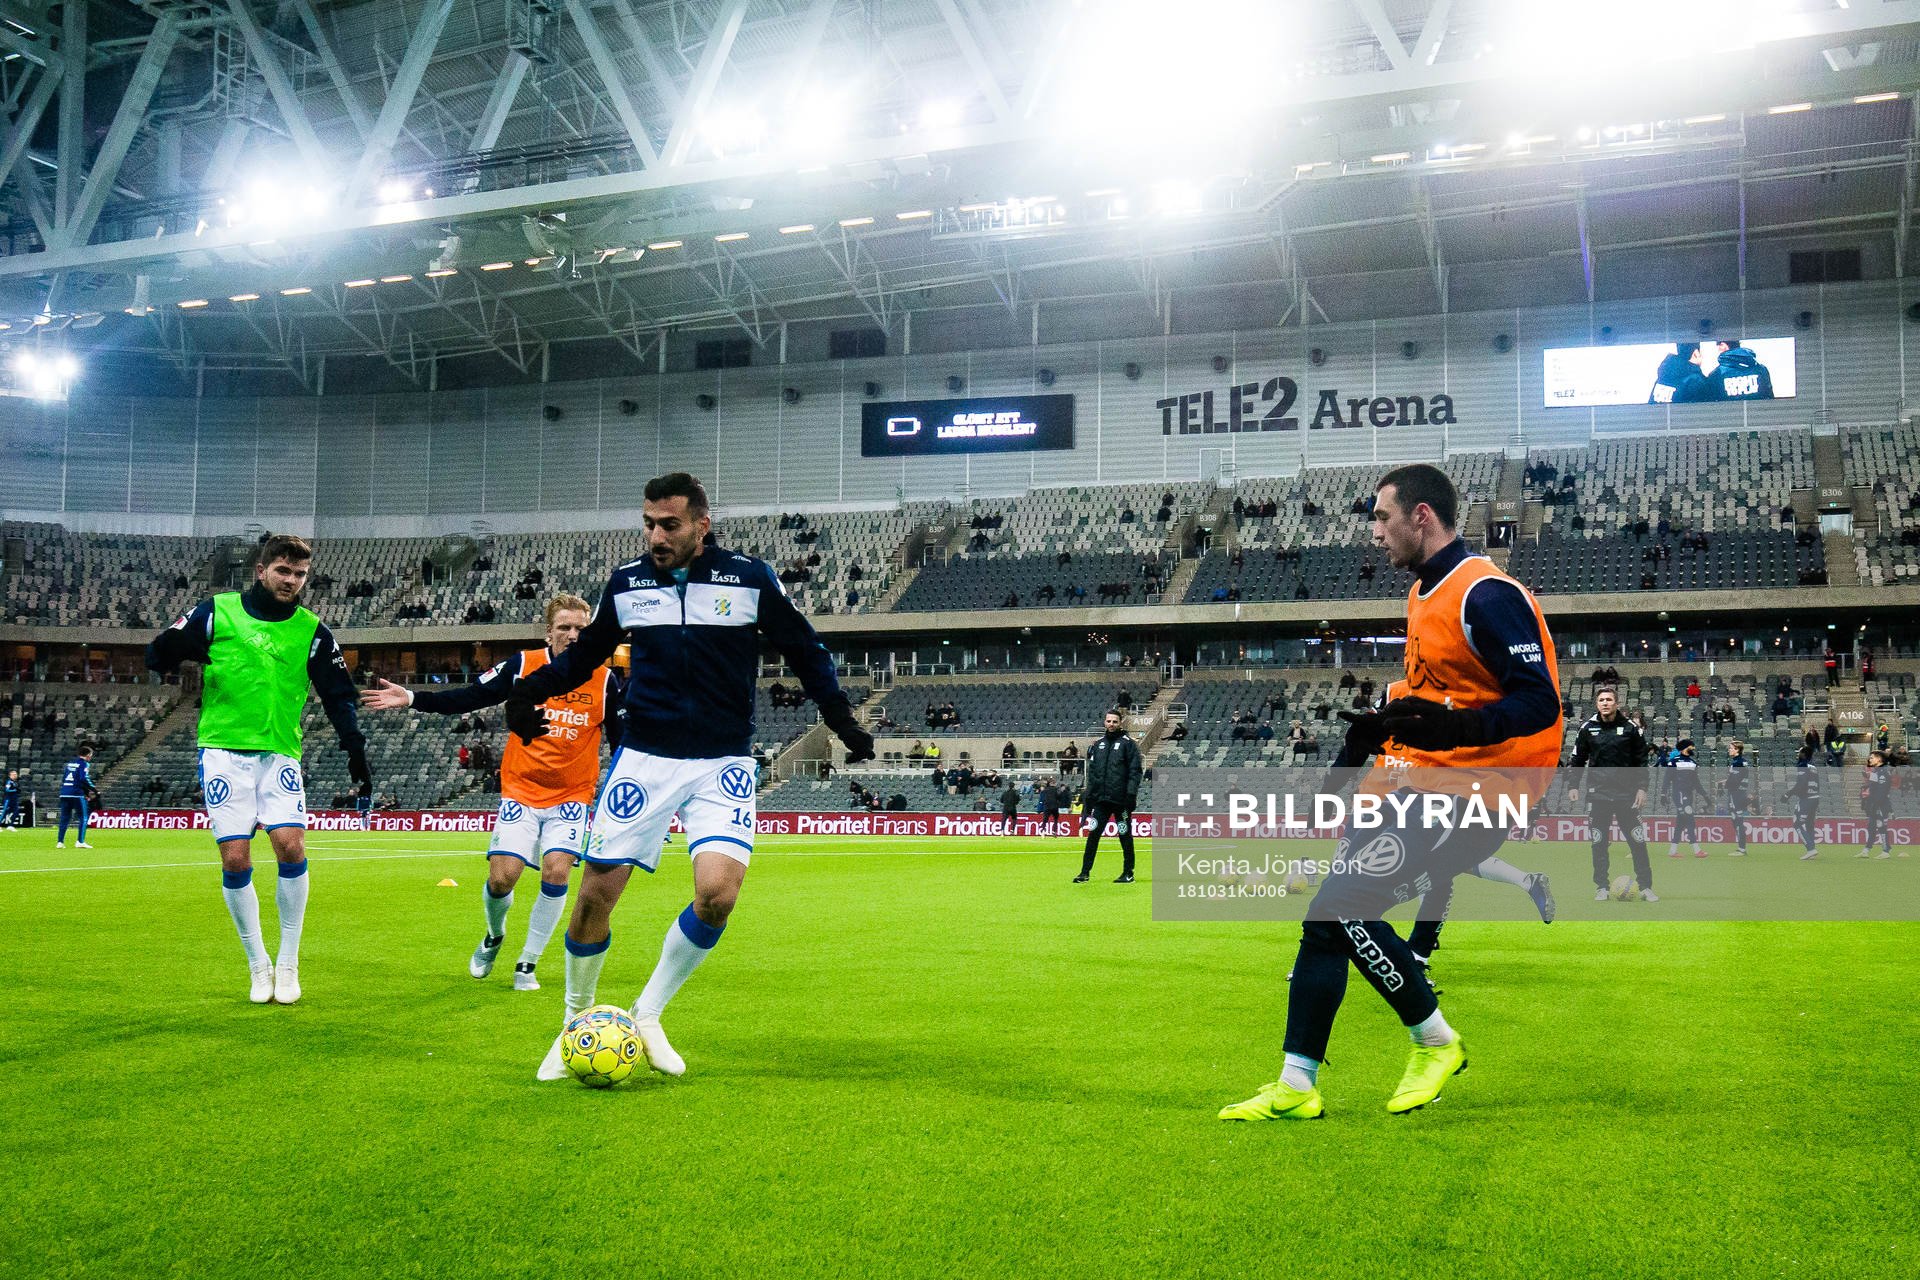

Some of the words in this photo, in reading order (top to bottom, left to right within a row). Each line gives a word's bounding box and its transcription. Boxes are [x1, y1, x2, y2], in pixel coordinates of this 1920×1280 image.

[1156, 376, 1299, 436] TELE2
[1310, 388, 1458, 430] Arena
[1822, 488, 1843, 497] B306
[1496, 502, 1515, 510] B307
[628, 577, 658, 588] RASTA
[711, 573, 741, 584] RASTA
[1839, 711, 1865, 720] A106
[87, 812, 145, 829] Prioritet
[146, 812, 188, 828] Finans
[369, 813, 414, 831] Finans
[420, 813, 485, 831] Prioritet
[731, 807, 752, 829] 16
[797, 815, 872, 834] Prioritet
[873, 815, 928, 835] Finans
[568, 829, 577, 841] 3
